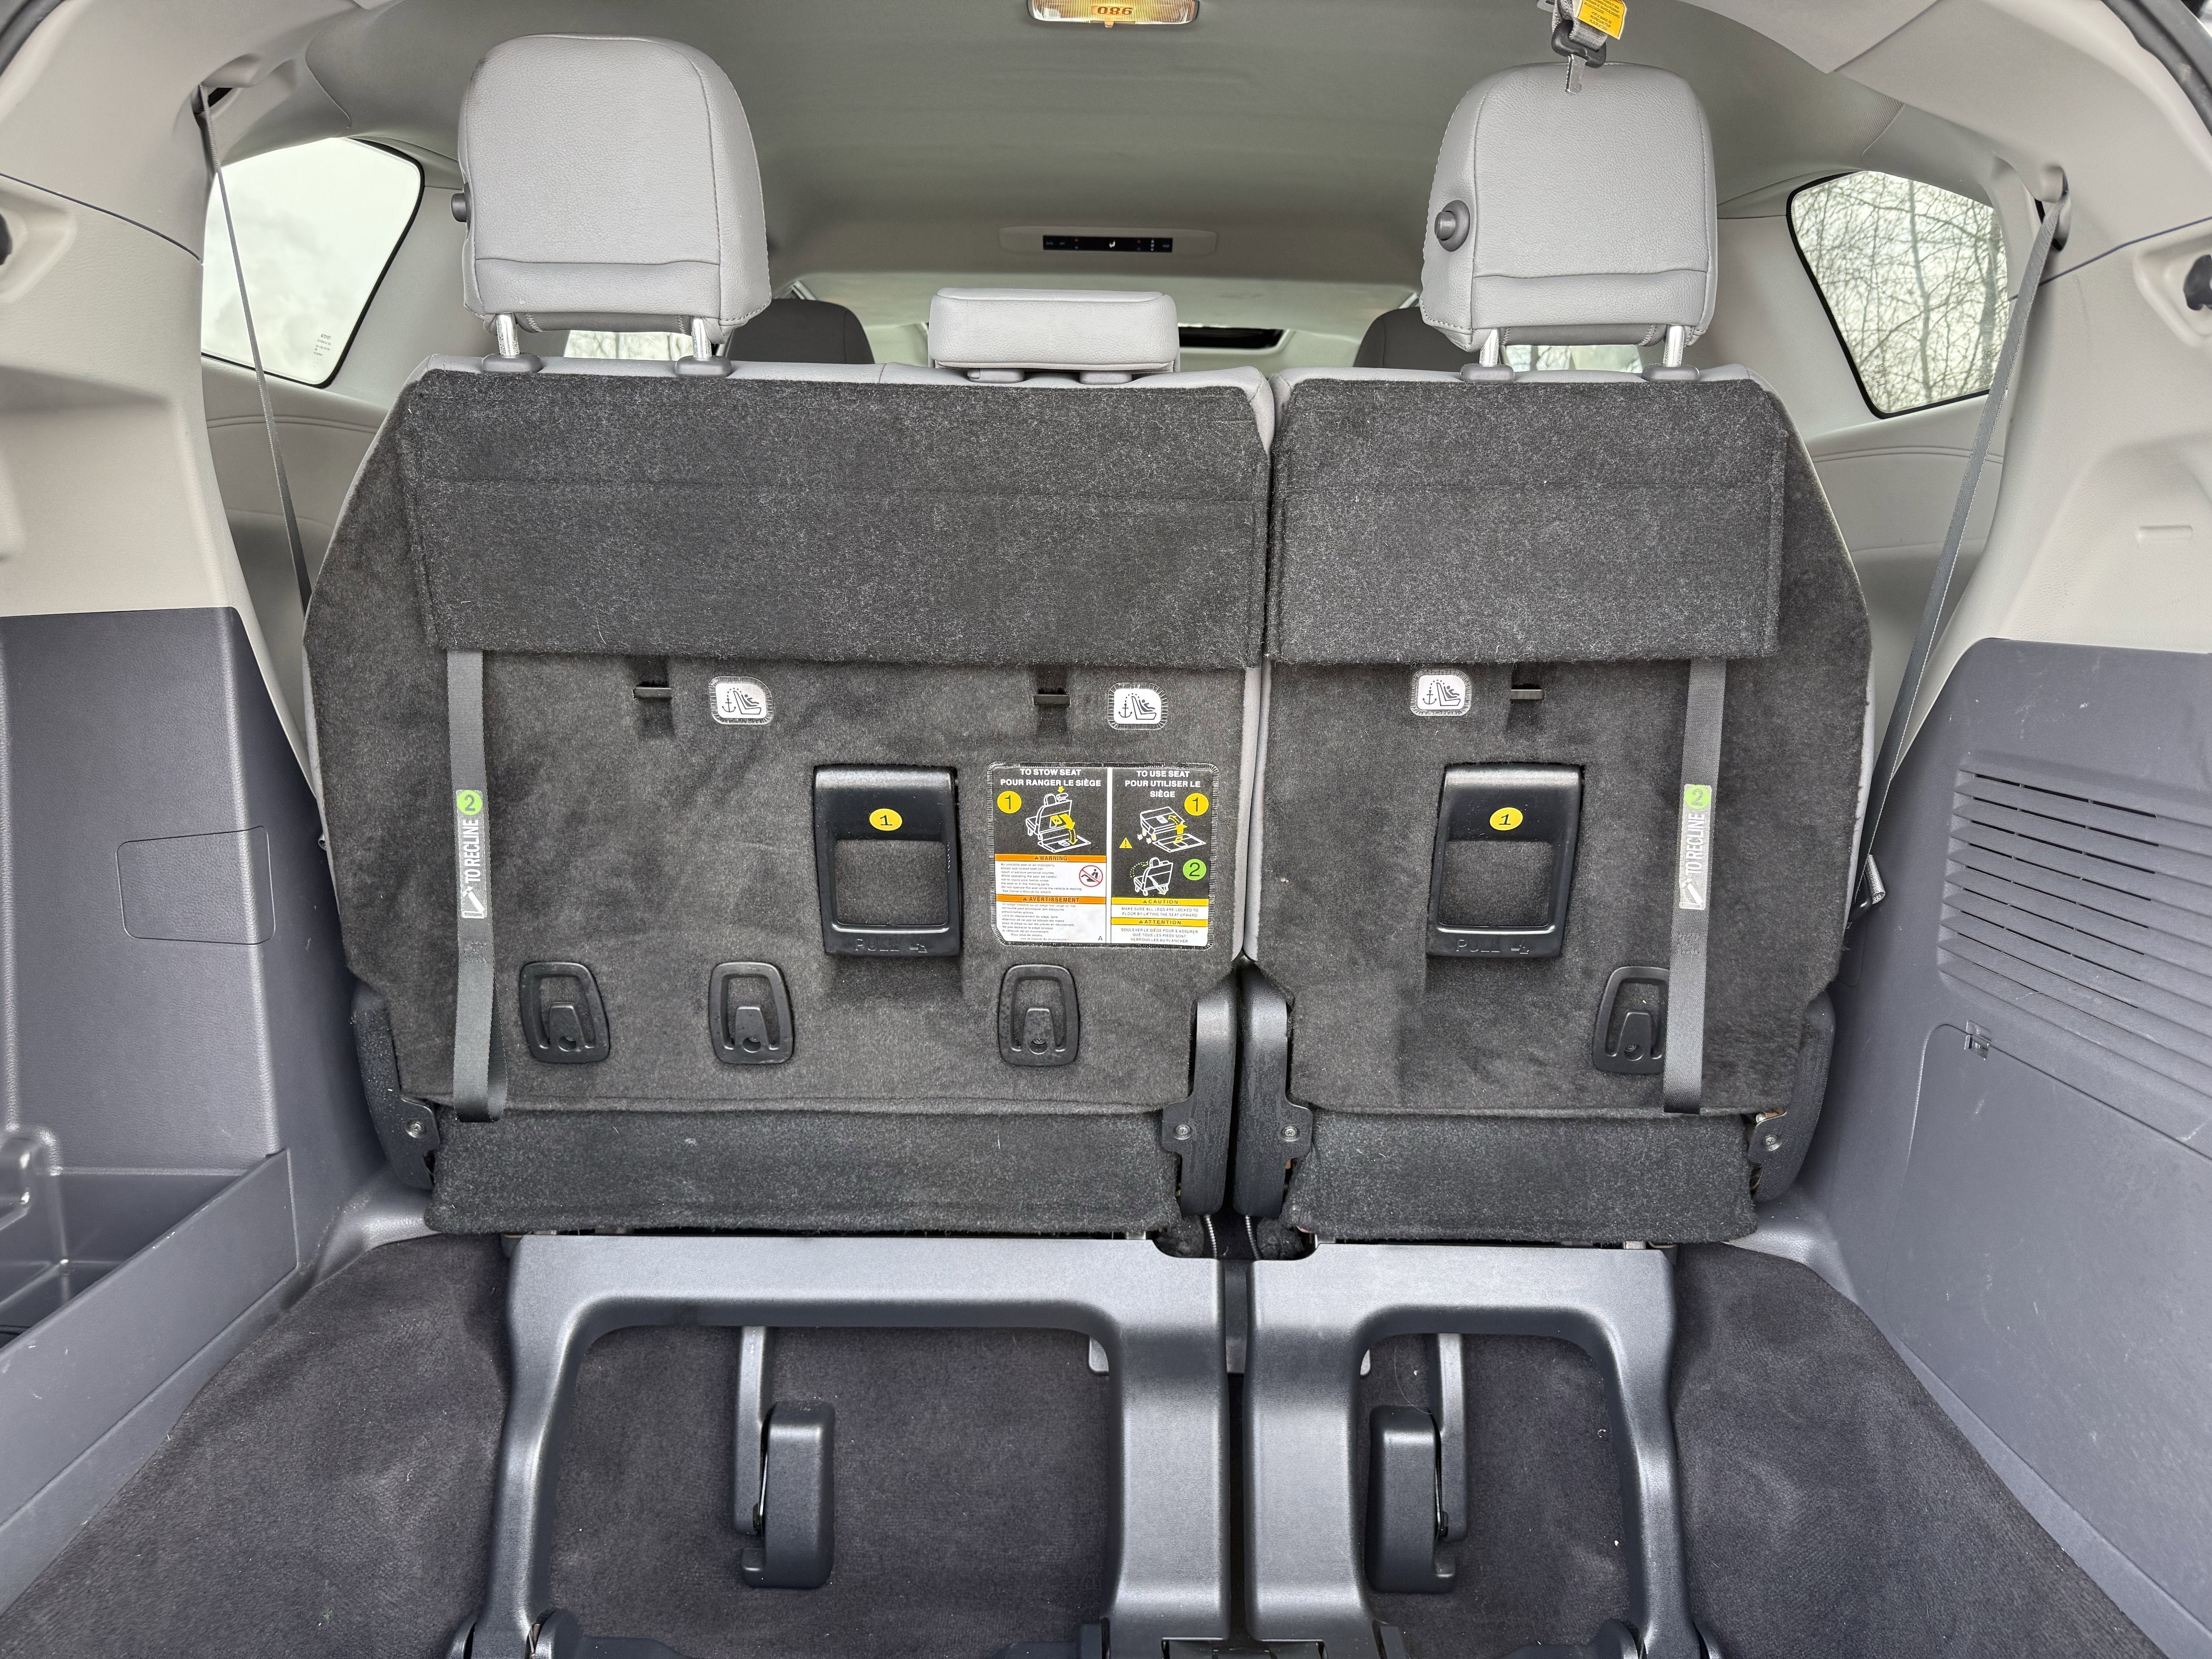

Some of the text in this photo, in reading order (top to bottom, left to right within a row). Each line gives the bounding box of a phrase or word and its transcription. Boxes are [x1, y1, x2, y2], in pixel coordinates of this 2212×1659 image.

[1076, 778, 1101, 787] SIÈGE
[1150, 789, 1175, 798] SIÈGE
[1692, 789, 1704, 806] 2
[465, 795, 476, 811] 2
[1005, 795, 1011, 809] 1
[1192, 797, 1198, 812] 1
[880, 815, 893, 826] 1
[1499, 814, 1511, 825] 1
[1685, 813, 1705, 875] TO RECLINE
[463, 819, 481, 883] TO RECLINE
[1189, 864, 1200, 877] 2
[855, 938, 899, 951] PULL
[1456, 939, 1500, 952] PULL
